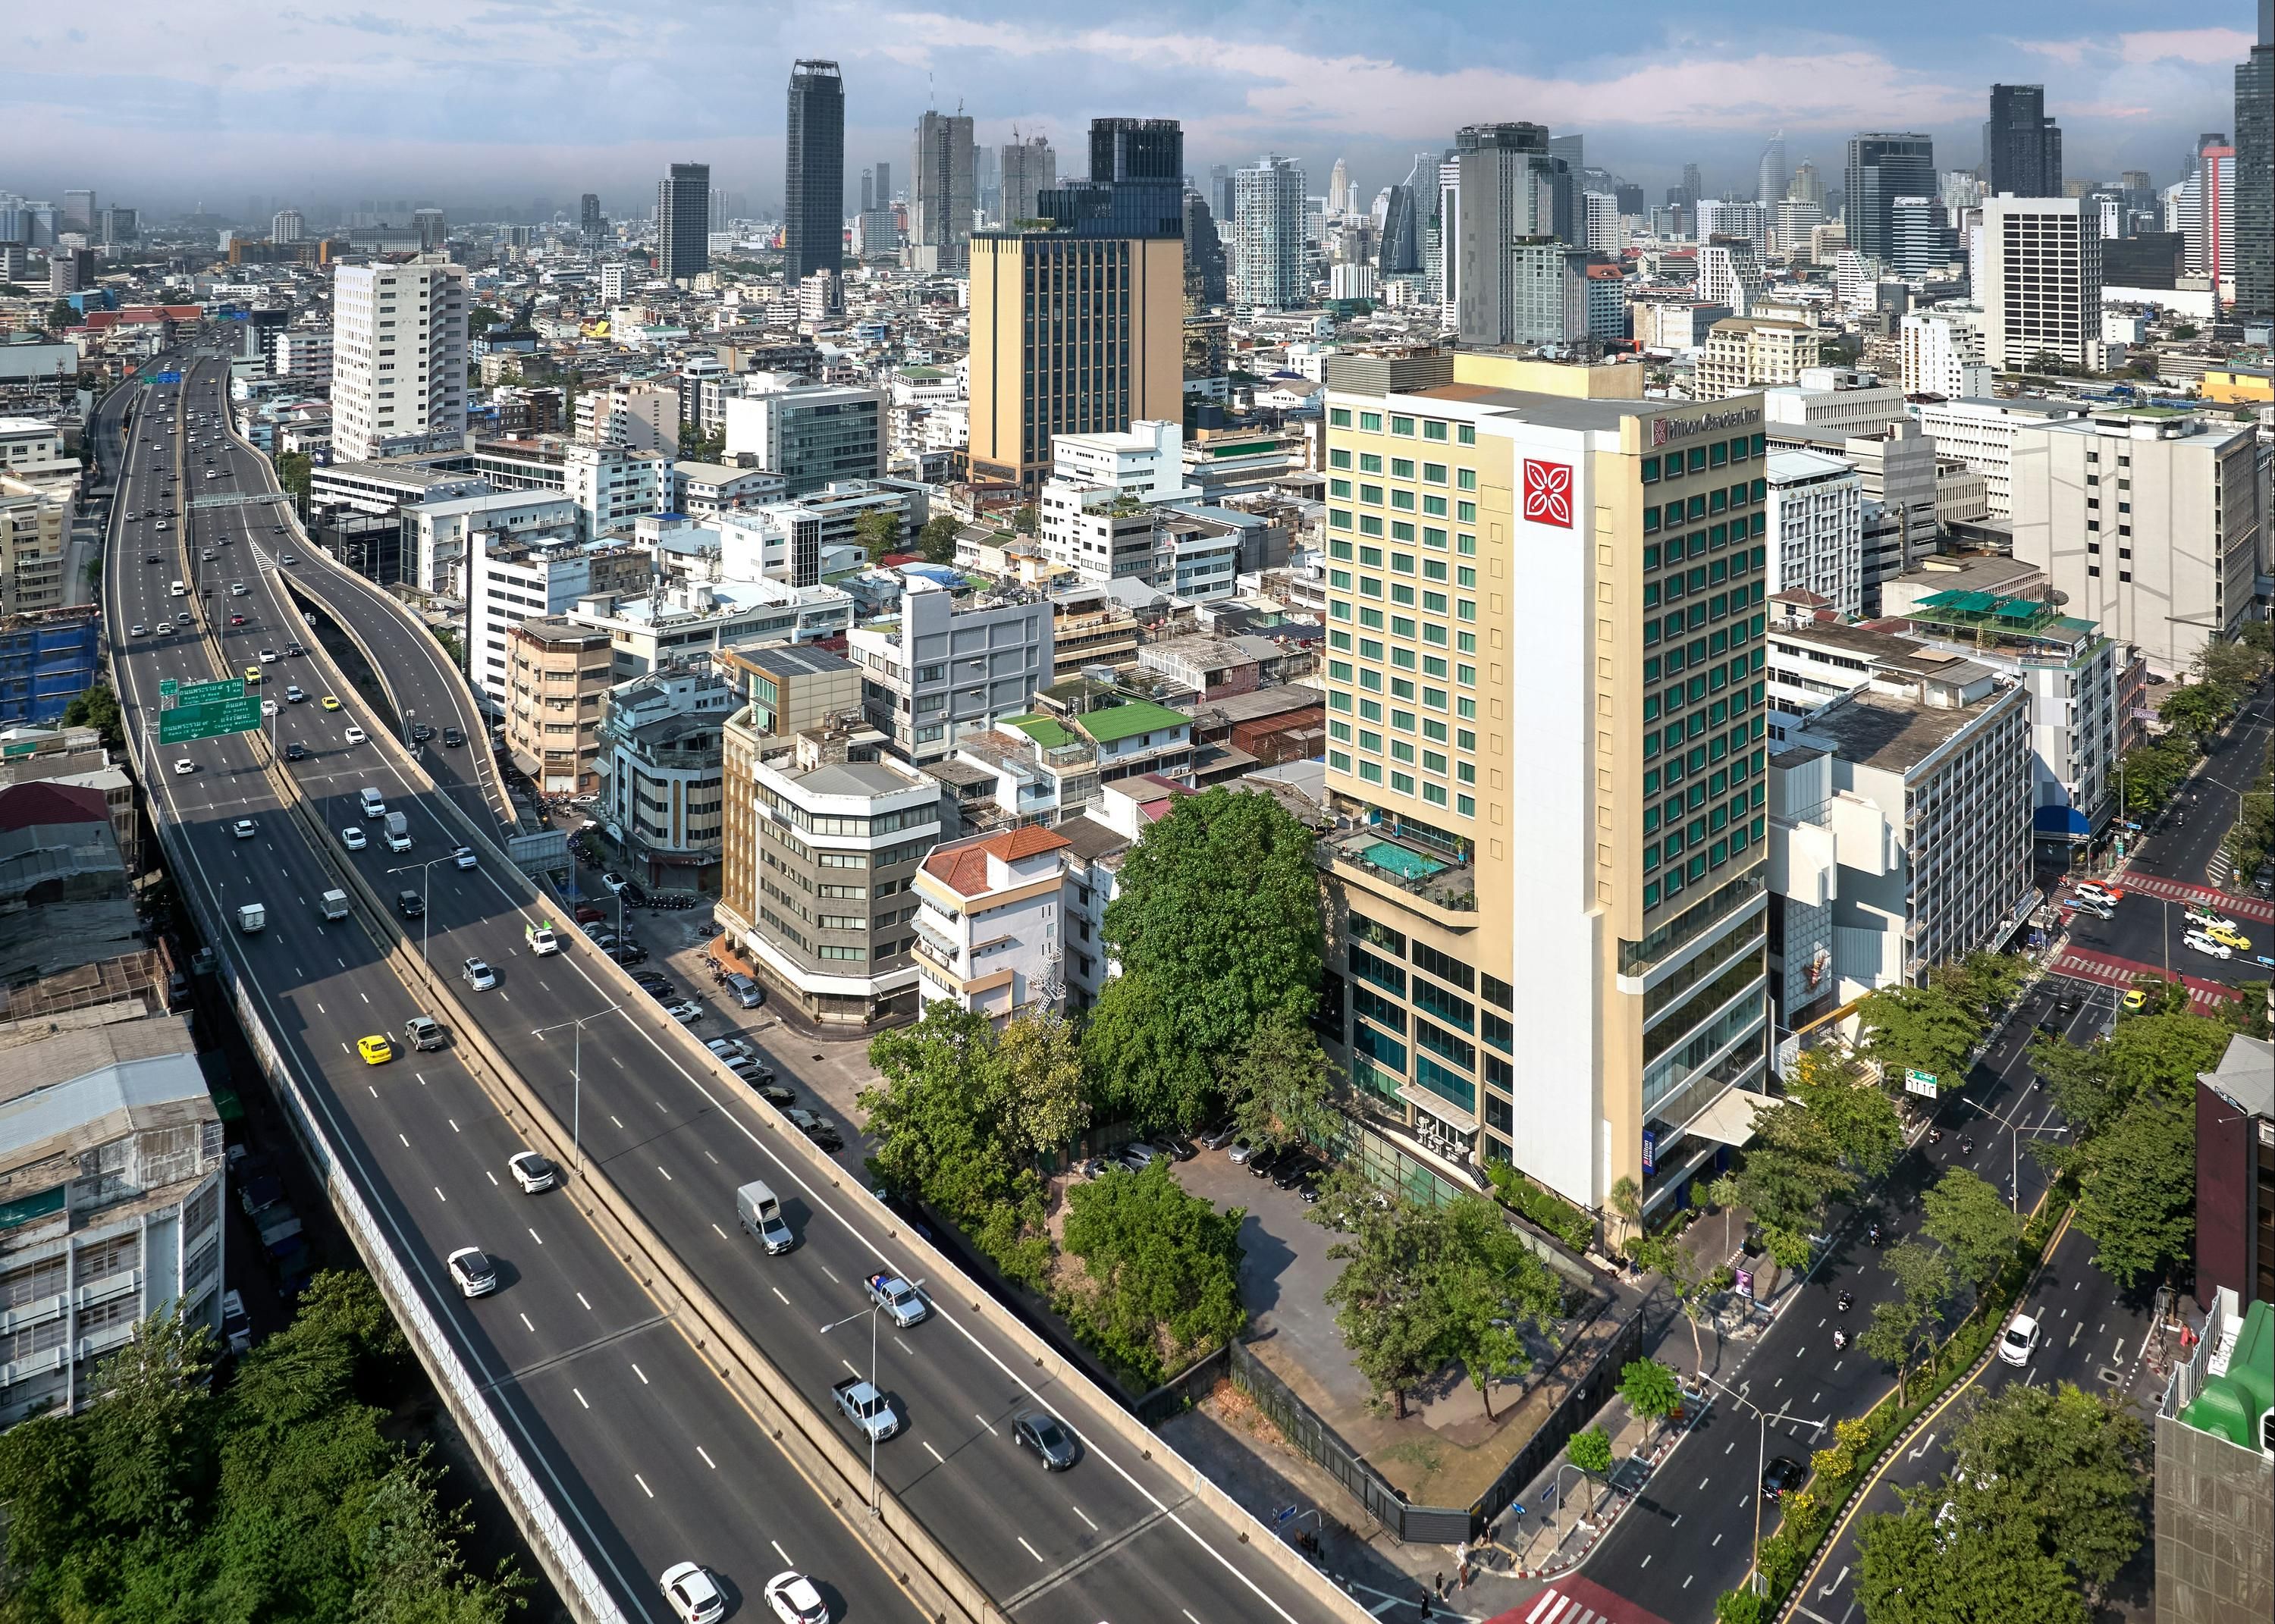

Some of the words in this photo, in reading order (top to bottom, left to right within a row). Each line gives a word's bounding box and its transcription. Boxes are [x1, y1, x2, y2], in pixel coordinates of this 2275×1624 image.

[1667, 416, 1699, 439] Hilton
[1701, 409, 1741, 431] Garden
[1740, 406, 1759, 424] Inn
